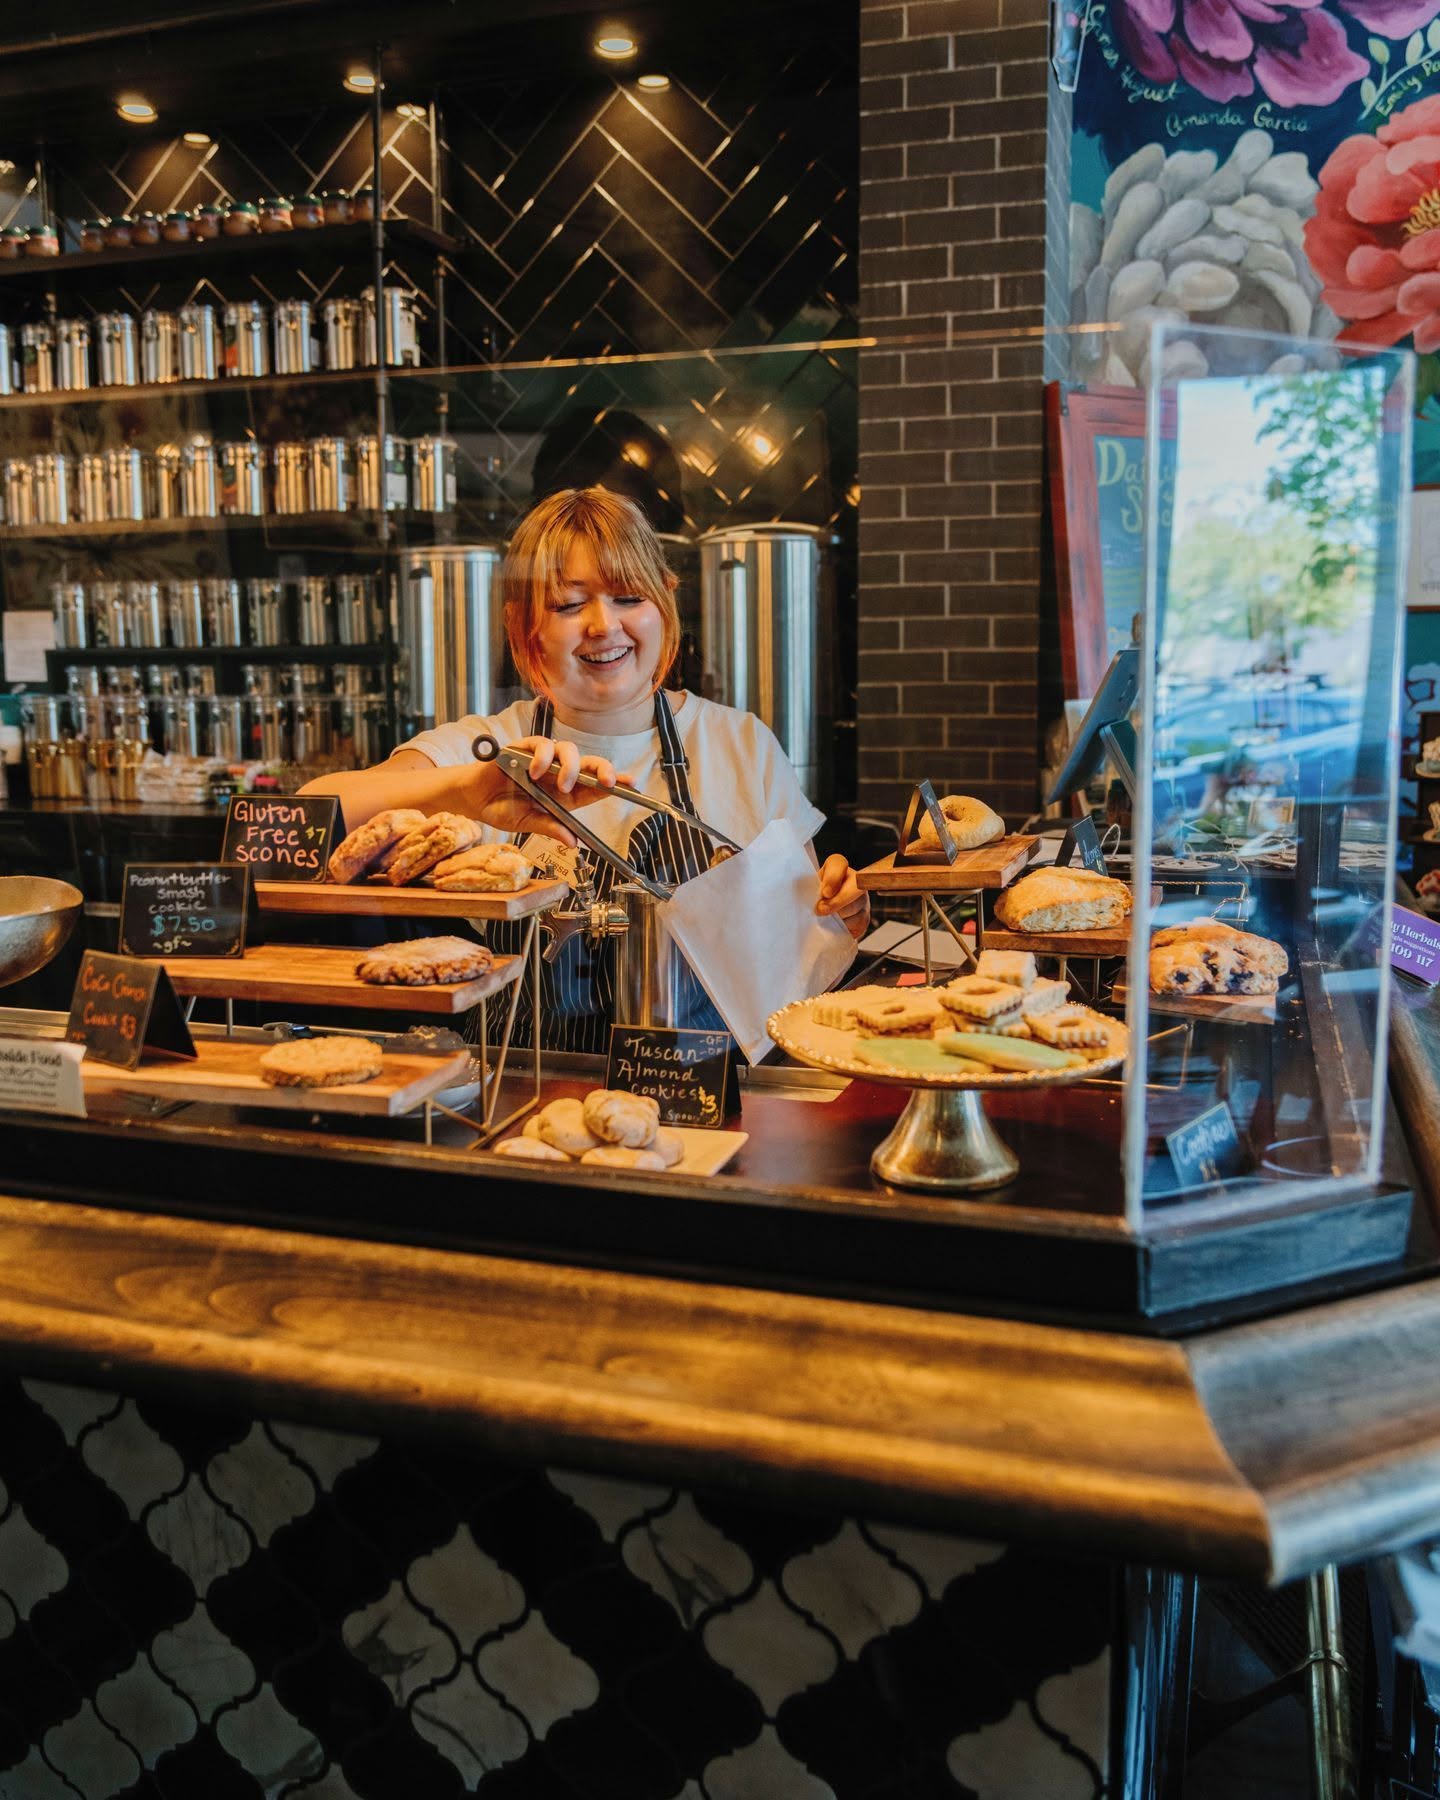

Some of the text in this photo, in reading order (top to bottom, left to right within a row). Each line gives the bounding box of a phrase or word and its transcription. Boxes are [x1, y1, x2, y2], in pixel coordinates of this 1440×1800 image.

[234, 800, 307, 825] Gluten
[246, 826, 327, 846] Free $7
[149, 914, 217, 937] $7.50
[624, 1036, 702, 1063] Tuscan
[617, 1058, 699, 1083] Almond
[631, 1083, 698, 1100] Cookies
